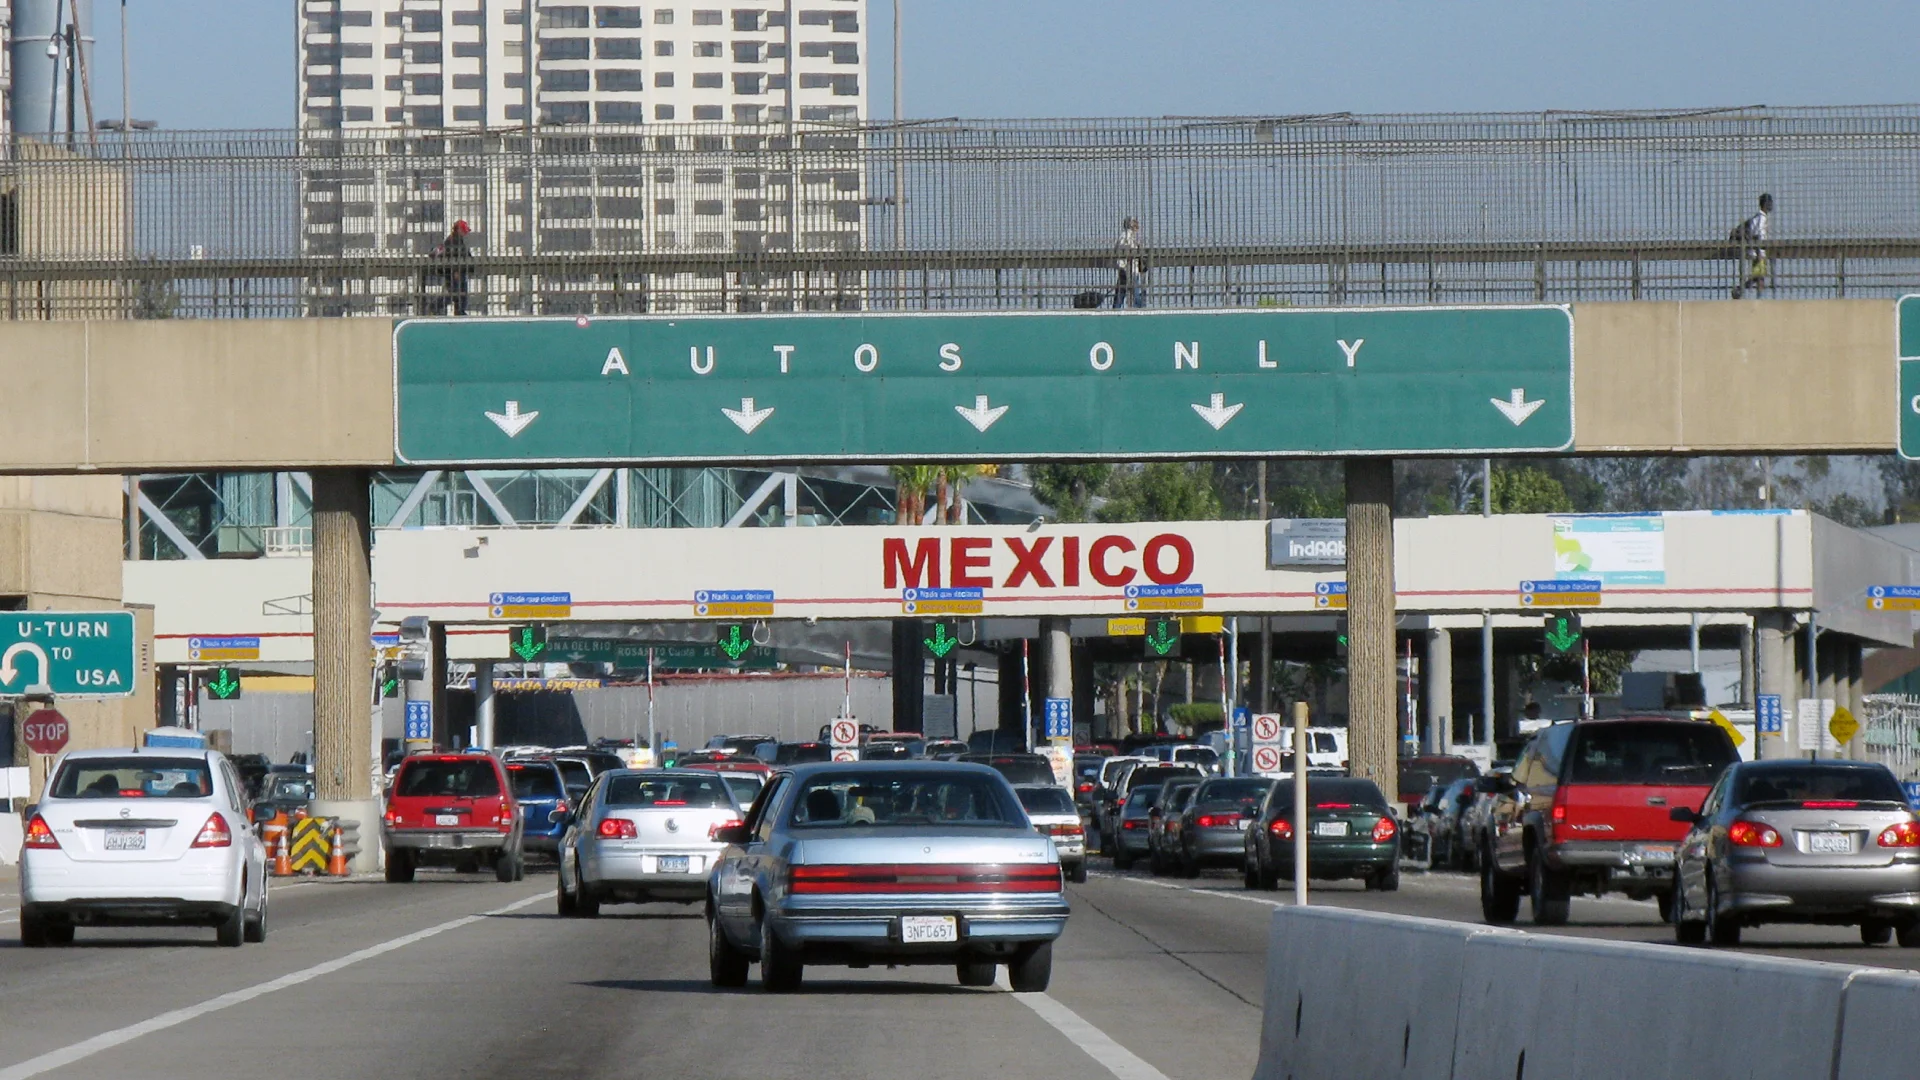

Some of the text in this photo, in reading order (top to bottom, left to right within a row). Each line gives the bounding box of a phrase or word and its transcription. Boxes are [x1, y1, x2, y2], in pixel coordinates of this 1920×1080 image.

[601, 338, 1364, 375] AUTOS ONLY
[883, 533, 1195, 589] MEXICO
[18, 621, 109, 637] U-TURN
[51, 646, 73, 660] TO
[571, 641, 591, 651] DEL
[592, 640, 611, 651] RIO
[75, 669, 121, 685] USA
[25, 723, 67, 741] STOP
